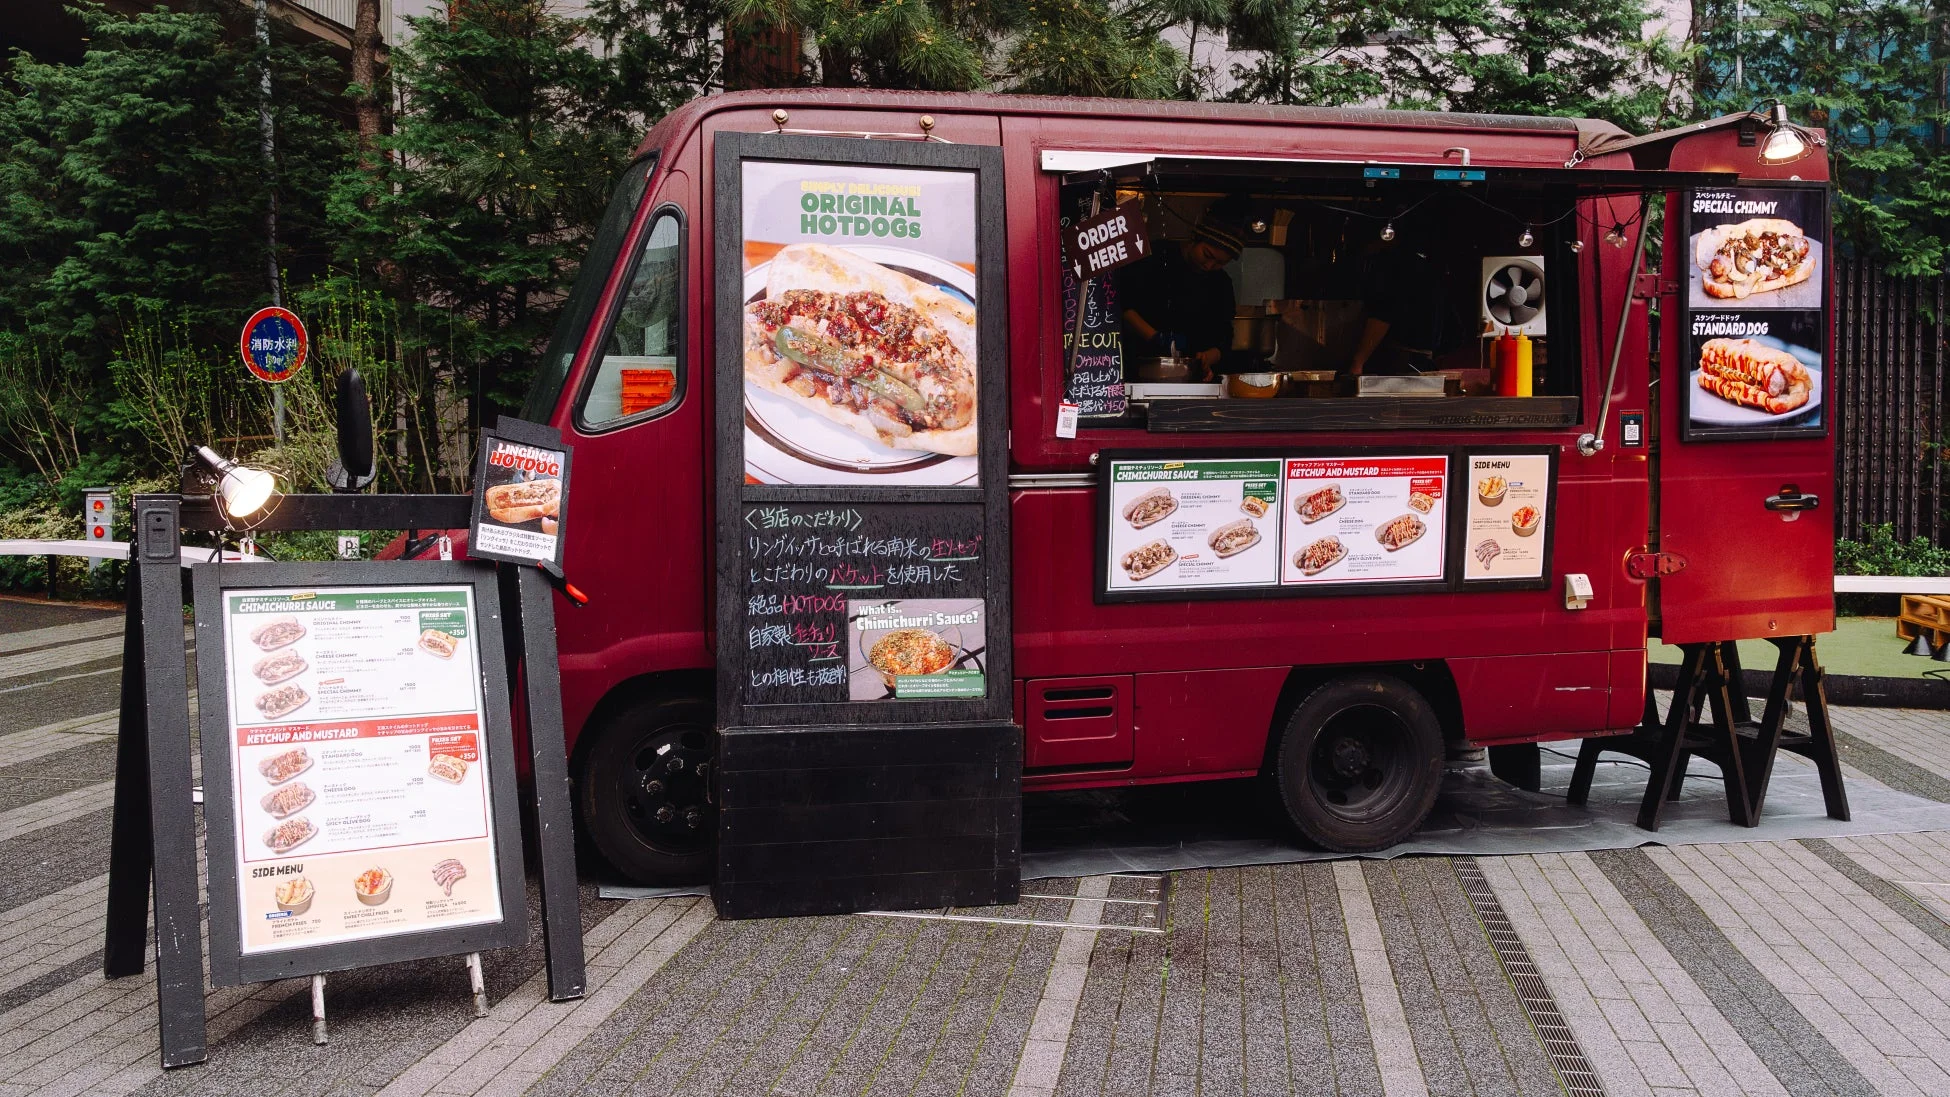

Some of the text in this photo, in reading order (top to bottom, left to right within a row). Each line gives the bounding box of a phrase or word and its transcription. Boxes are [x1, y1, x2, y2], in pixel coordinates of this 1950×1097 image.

[800, 193, 921, 217] ORIGINAL
[1693, 200, 1778, 214] SPECIAL CHIMMY
[1077, 215, 1128, 250] ORDER
[1088, 241, 1128, 272] HERE
[1692, 322, 1768, 335] STANDARD DOG
[251, 337, 297, 351] 消防水利
[1063, 332, 1120, 349] TAE OUT
[490, 451, 560, 476] HOTDOG
[1474, 461, 1511, 469] SIDE MENU
[1117, 471, 1172, 480] CHIMICHURRI
[1173, 470, 1198, 479] SAUCE
[1290, 468, 1326, 478] KETCHUP
[1326, 468, 1343, 477] AND
[1343, 467, 1379, 476] MUSTARD
[239, 601, 336, 613] CHIMICHURRI SAUCE
[859, 605, 886, 616] What
[857, 611, 979, 630] Chimichurri Sauce?
[809, 644, 838, 658] ソース
[246, 728, 358, 744] KETCHUP AND MUSTARD
[252, 864, 304, 878] SIDE MENU
